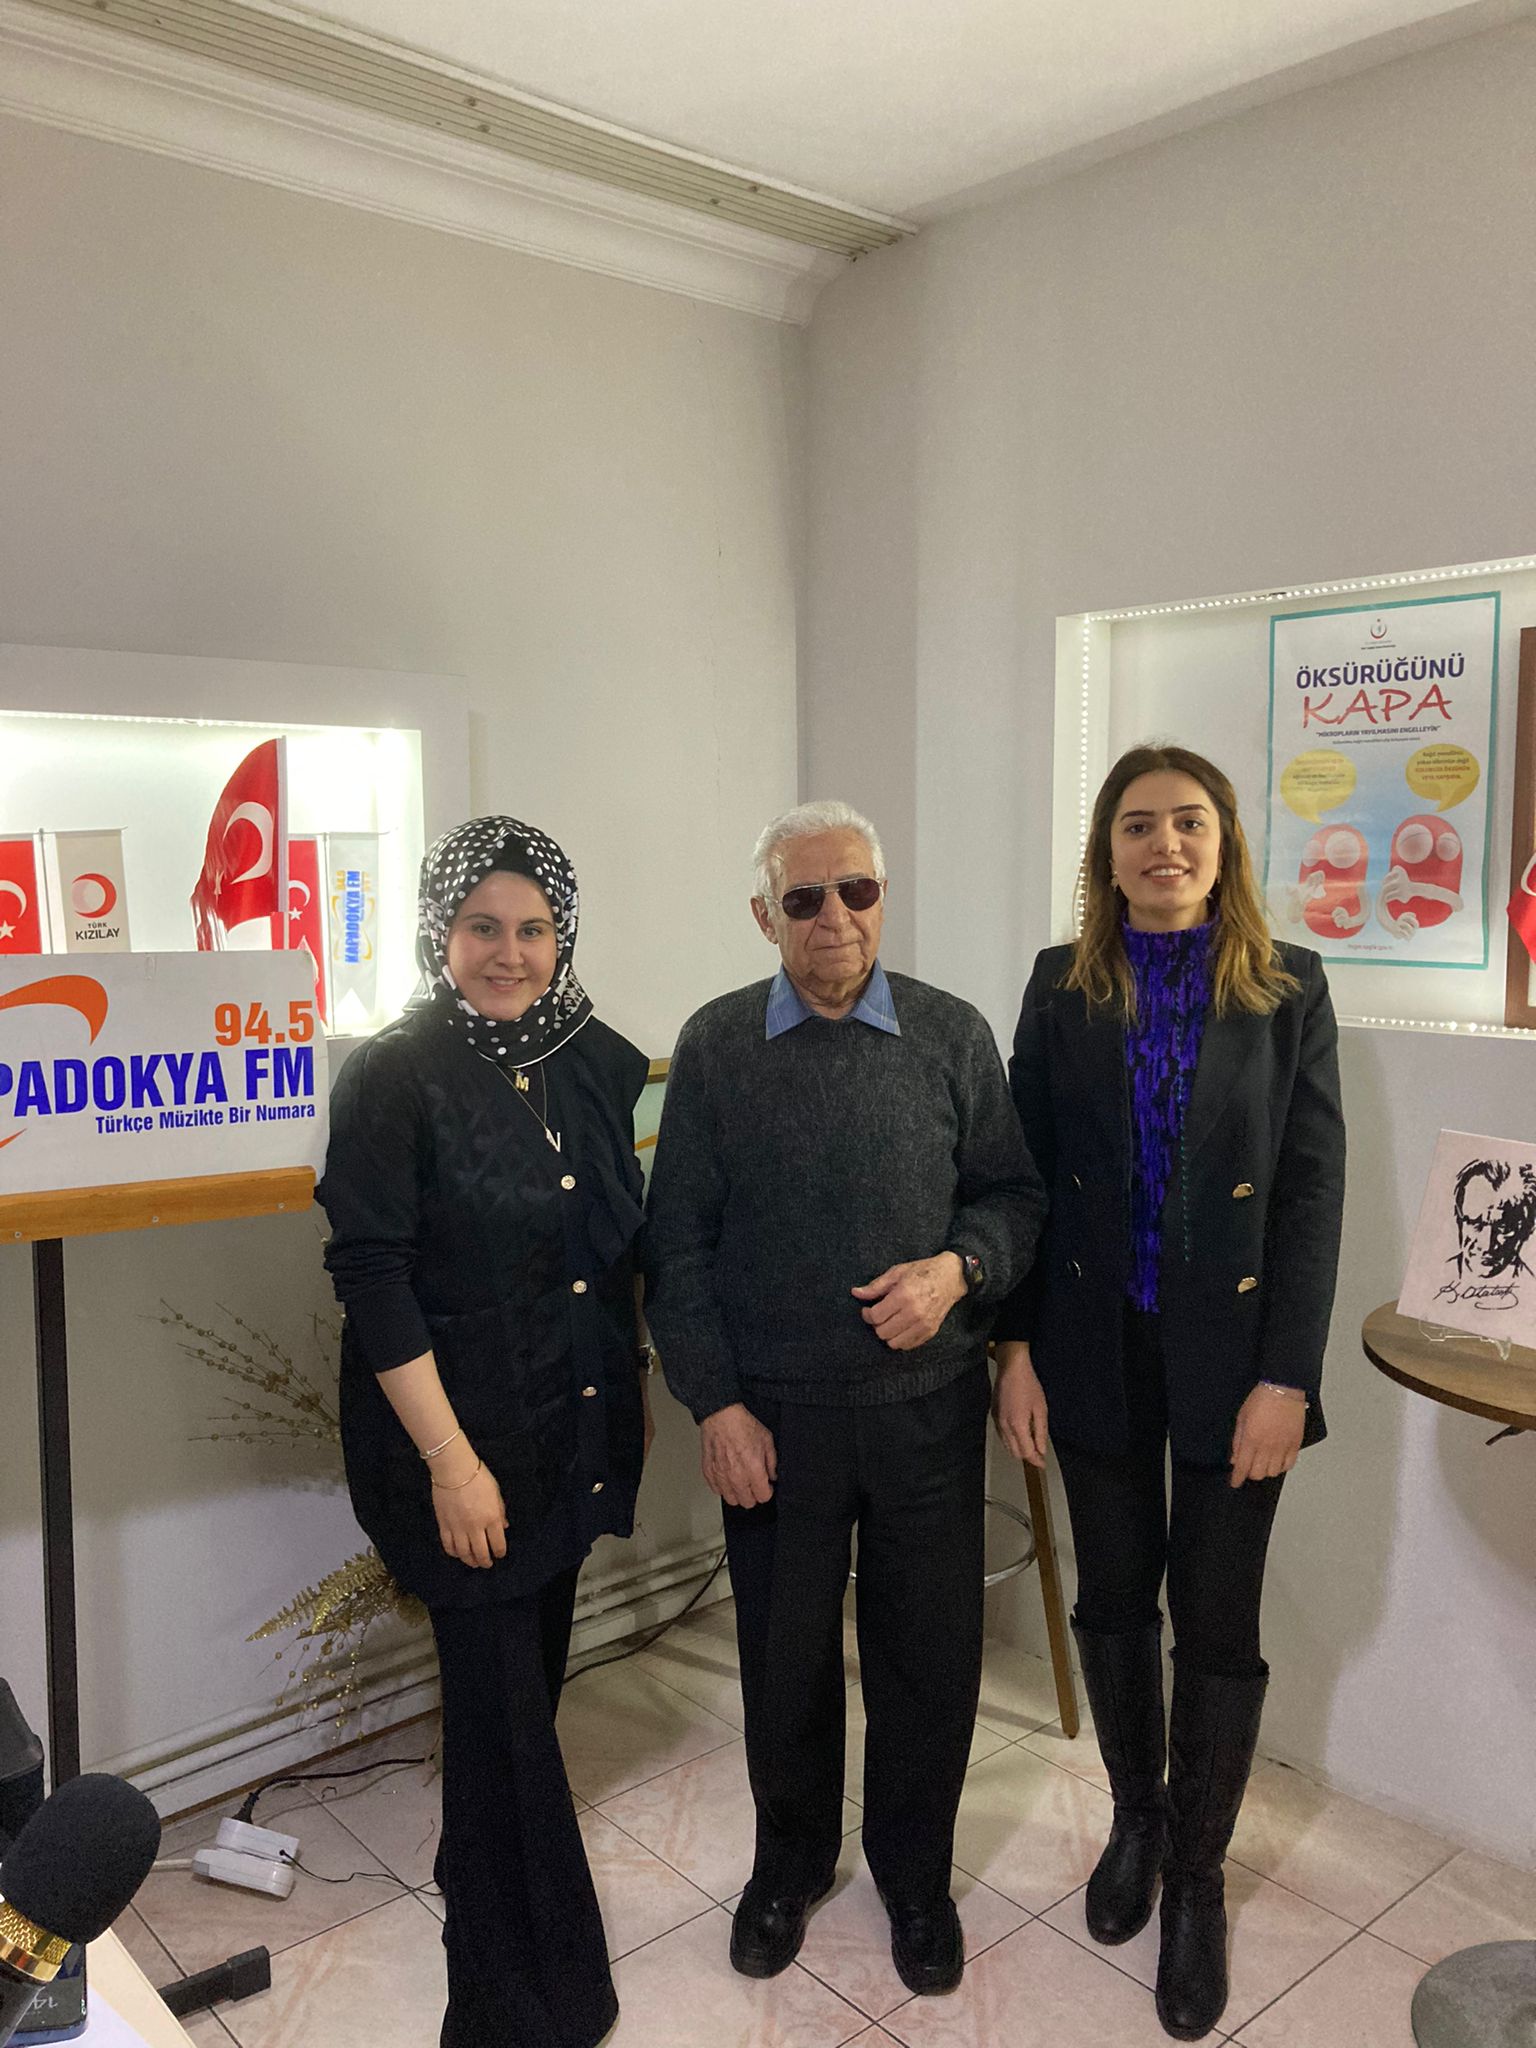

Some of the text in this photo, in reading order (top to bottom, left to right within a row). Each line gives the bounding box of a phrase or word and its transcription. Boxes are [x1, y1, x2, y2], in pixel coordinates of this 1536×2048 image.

[1296, 652, 1465, 690] ÖKSÜRÜĞÜNÜ
[1303, 683, 1453, 729] KAPA
[346, 871, 361, 888] FM
[75, 928, 120, 941] KIZILAY
[88, 921, 108, 929] TÜRK
[214, 1000, 315, 1047] 94.5
[245, 1046, 315, 1101] FM
[96, 1103, 316, 1135] Türkçe Müzikte Bir Numara
